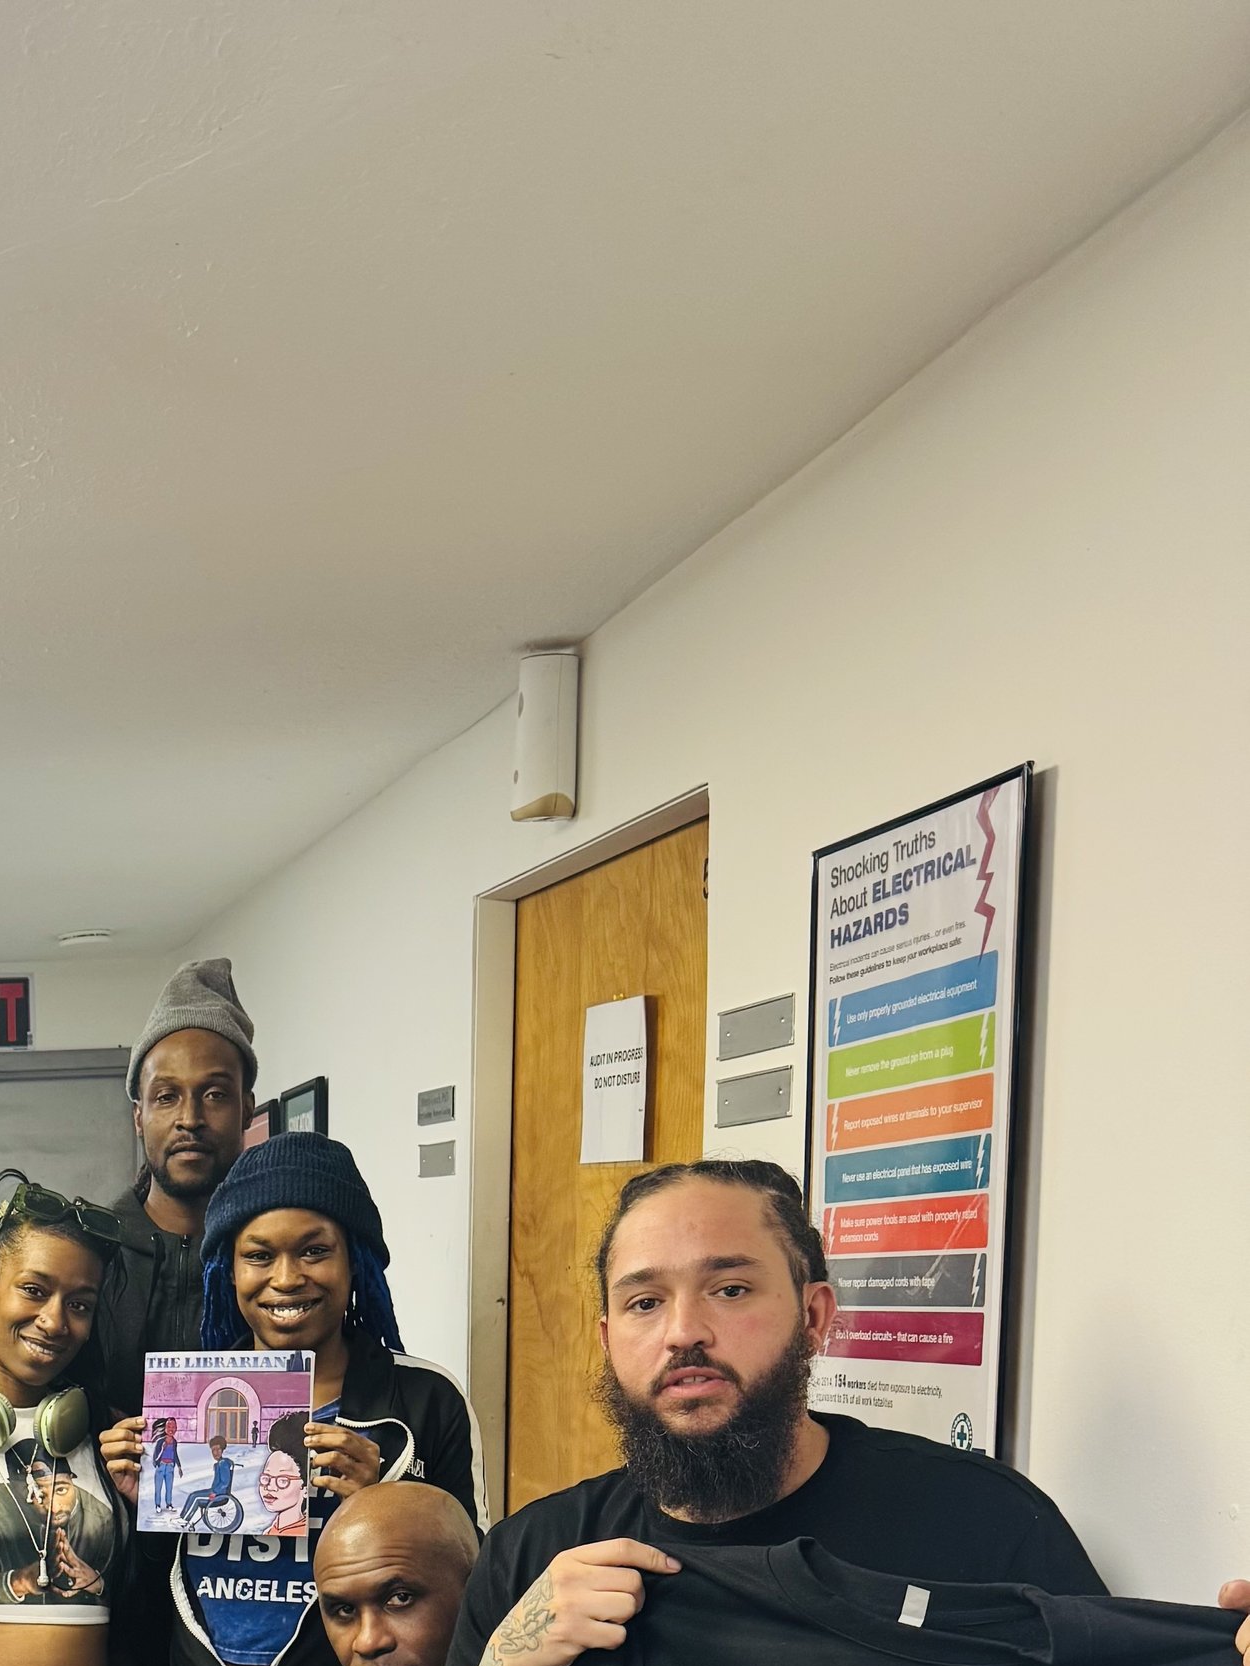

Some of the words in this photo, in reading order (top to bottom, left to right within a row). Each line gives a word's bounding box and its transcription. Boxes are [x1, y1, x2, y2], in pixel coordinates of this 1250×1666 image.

[830, 848, 889, 888] Shocking
[893, 831, 936, 862] Truths
[830, 887, 868, 919] About
[872, 844, 976, 904] ELECTRICAL
[830, 902, 909, 949] HAZARDS
[892, 955, 906, 965] keep
[907, 951, 917, 963] your
[918, 941, 948, 957] workplace
[846, 1013, 857, 1024] Use
[857, 1010, 868, 1022] only
[868, 1003, 891, 1020] properly
[892, 996, 917, 1015] grounded
[918, 988, 946, 1005] electrical
[947, 979, 977, 998] equipment
[590, 1053, 605, 1067] AUDIT
[606, 1052, 613, 1064] IN
[614, 1047, 643, 1062] PROGRESS
[880, 1060, 890, 1069] the
[940, 1046, 954, 1061] plug
[594, 1077, 603, 1089] DO
[603, 1075, 616, 1088] NOT
[616, 1071, 640, 1086] DISTURB
[844, 1118, 860, 1132] Report
[861, 1115, 882, 1128] exposed
[899, 1112, 906, 1121] or
[930, 1105, 937, 1115] to
[938, 1103, 952, 1117] your
[953, 1099, 983, 1113] supervisor
[842, 1172, 856, 1184] Never
[856, 1171, 865, 1181] use
[865, 1170, 872, 1180] an
[872, 1166, 897, 1179] electrical
[921, 1163, 931, 1174] has
[932, 1159, 959, 1174] exposed
[840, 1217, 854, 1228] Make
[854, 1219, 865, 1228] sure
[866, 1216, 882, 1228] power
[899, 1215, 907, 1224] are
[907, 1213, 921, 1223] used
[921, 1211, 934, 1221] with
[935, 1209, 961, 1224] properly
[868, 1277, 894, 1290] damaged
[909, 1275, 921, 1287] with
[850, 1330, 872, 1341] overload
[908, 1334, 918, 1342] can
[919, 1334, 937, 1343] cause
[943, 1333, 953, 1344] fire
[146, 1356, 181, 1369] THE
[184, 1356, 287, 1369] LIBRARIAN
[196, 1576, 318, 1603] ANGELES
